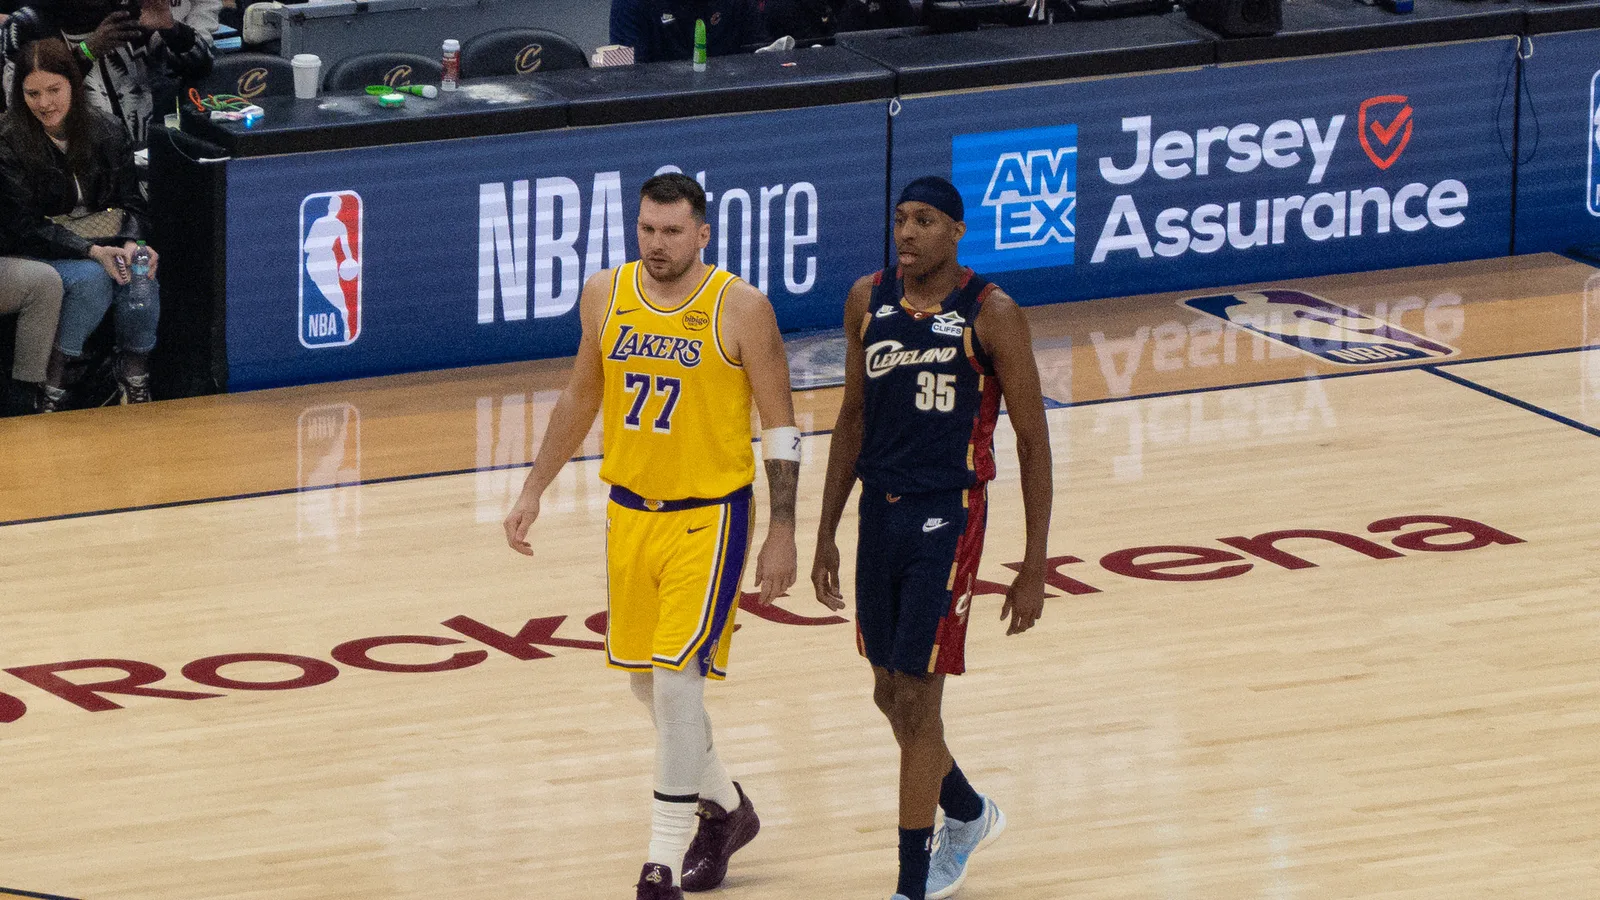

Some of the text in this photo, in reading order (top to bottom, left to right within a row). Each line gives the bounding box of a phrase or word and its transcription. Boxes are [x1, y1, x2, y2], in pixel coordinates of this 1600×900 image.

[1099, 114, 1346, 184] Jersey
[1090, 179, 1469, 263] Assurance
[477, 171, 627, 324] NBA
[308, 312, 337, 338] NBA
[606, 325, 704, 369] LAKERS
[932, 323, 962, 335] CLIFFS
[865, 340, 957, 379] CLEVELAND
[1328, 345, 1411, 363] NBA
[623, 372, 681, 435] 77
[915, 371, 957, 412] 35
[971, 514, 1528, 598] rena
